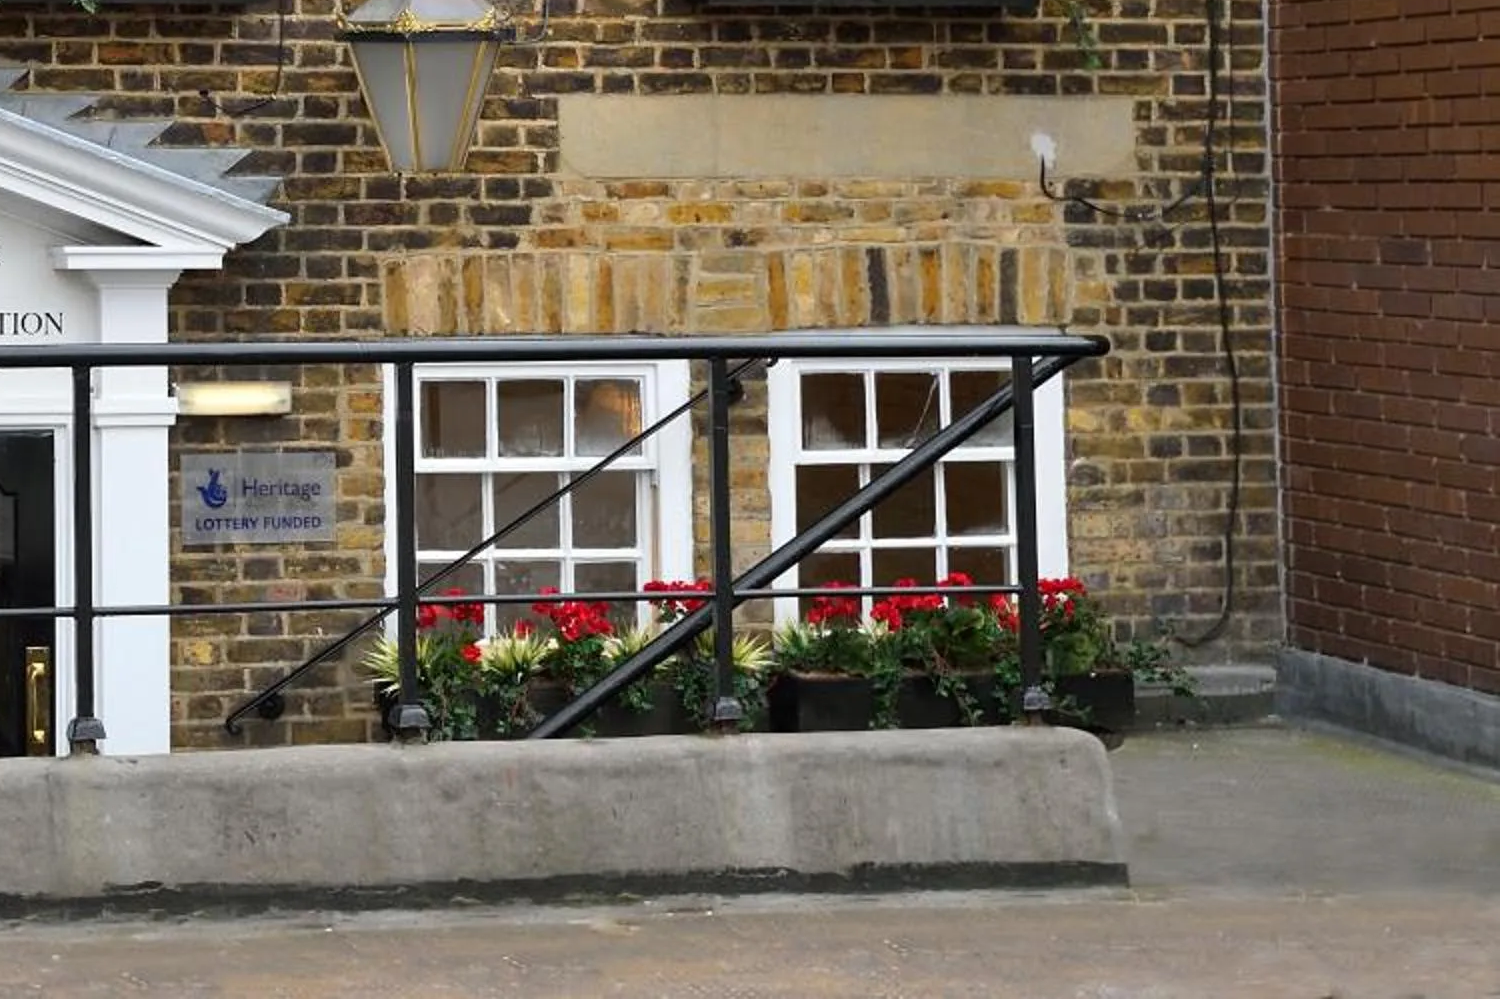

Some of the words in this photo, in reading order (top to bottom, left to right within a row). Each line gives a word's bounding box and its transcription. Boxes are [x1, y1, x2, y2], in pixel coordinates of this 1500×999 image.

[242, 477, 321, 501] Heritage
[195, 516, 258, 531] LOTTERY
[264, 516, 321, 529] FUNDED
